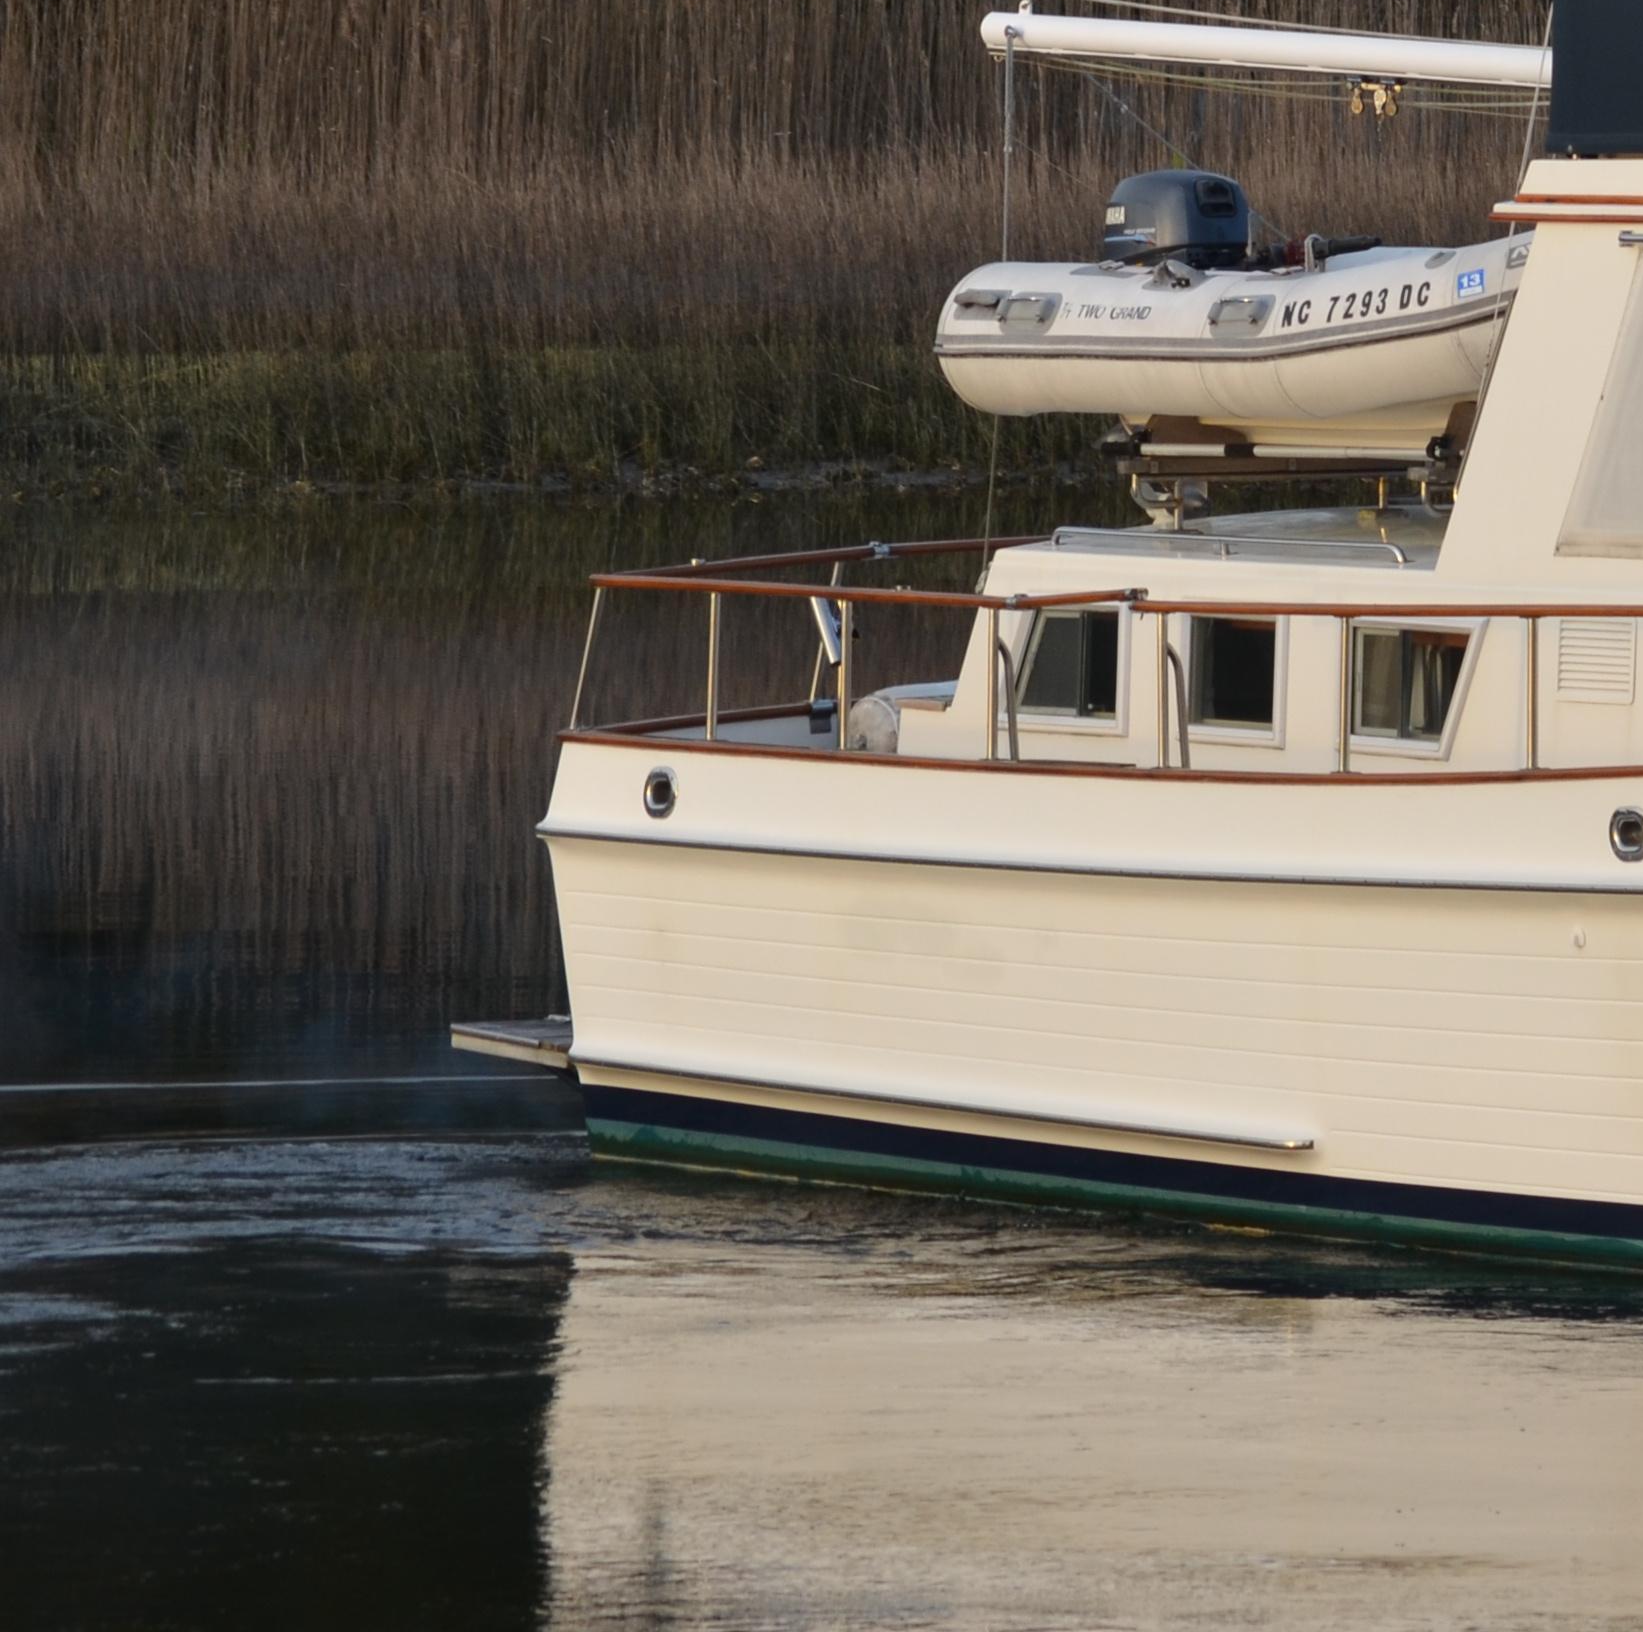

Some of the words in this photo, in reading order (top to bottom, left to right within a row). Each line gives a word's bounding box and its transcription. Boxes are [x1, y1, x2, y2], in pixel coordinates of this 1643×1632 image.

[1460, 274, 1481, 288] 13
[1078, 304, 1107, 320] TWO
[1110, 305, 1153, 321] GRAND
[1281, 299, 1312, 328] NC
[1326, 287, 1389, 323] 7293
[1399, 281, 1431, 310] DC
